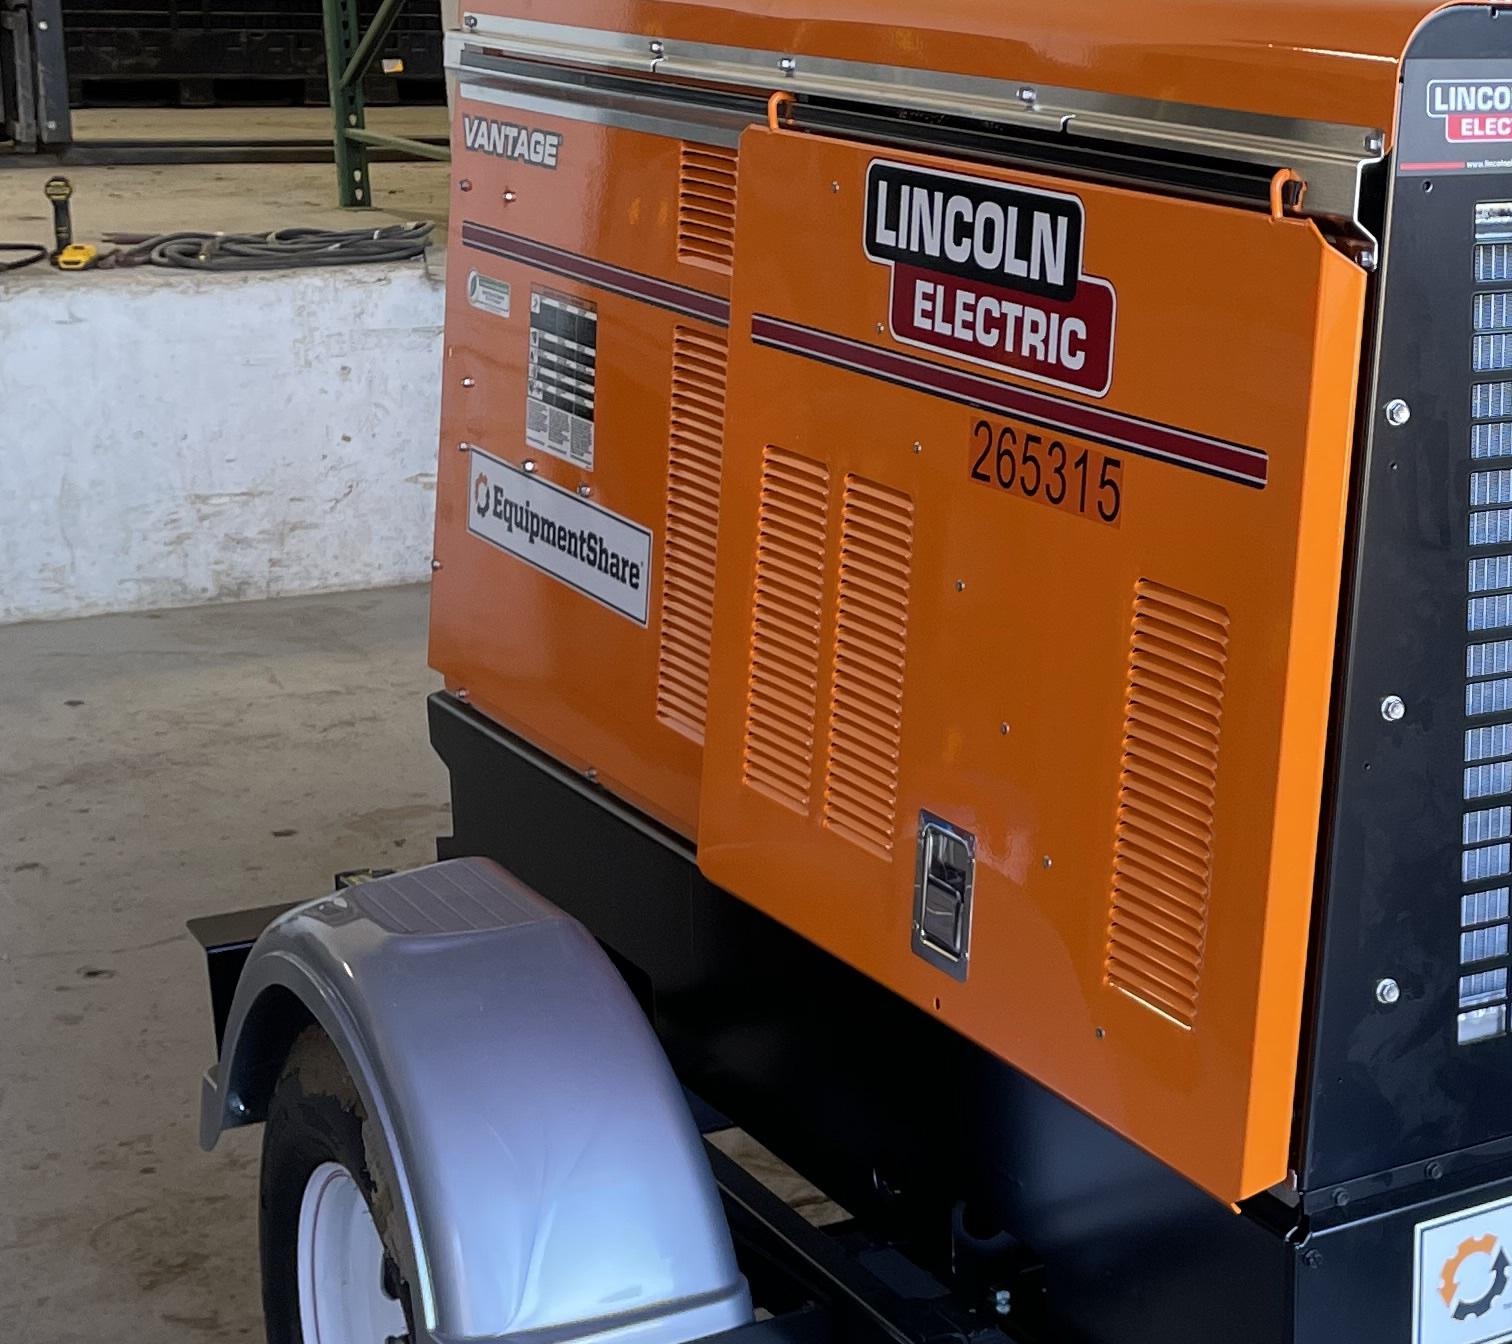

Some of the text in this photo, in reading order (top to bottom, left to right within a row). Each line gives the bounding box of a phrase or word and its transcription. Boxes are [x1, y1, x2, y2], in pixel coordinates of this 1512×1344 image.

[463, 116, 560, 168] VANTAGE
[874, 179, 1069, 286] LINCOLN
[912, 279, 1088, 371] ELECTRIC
[970, 419, 1122, 523] 265315
[492, 484, 642, 590] EquipmentShare
